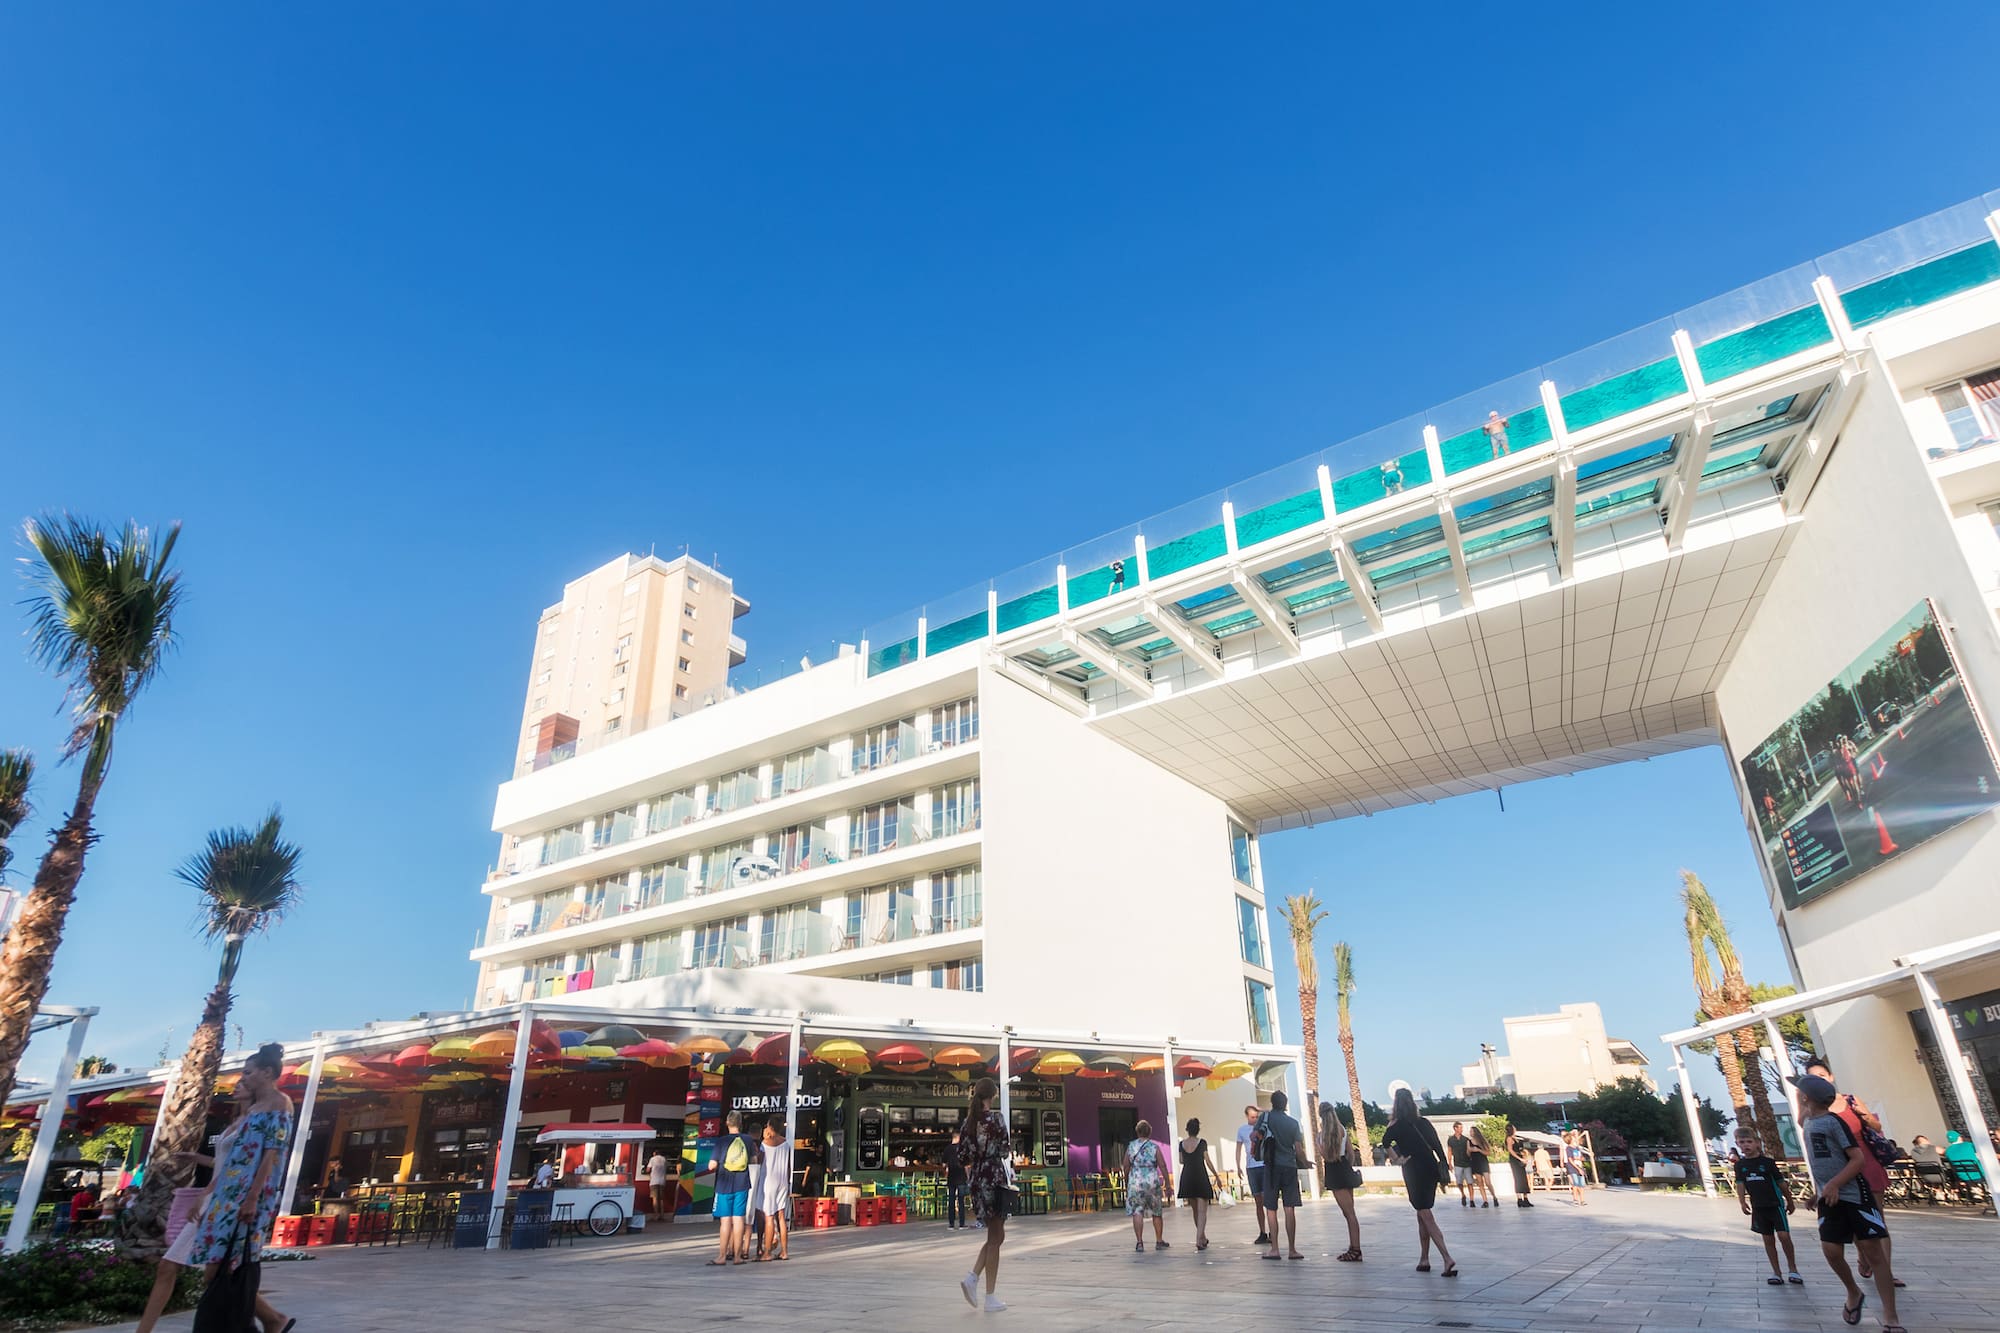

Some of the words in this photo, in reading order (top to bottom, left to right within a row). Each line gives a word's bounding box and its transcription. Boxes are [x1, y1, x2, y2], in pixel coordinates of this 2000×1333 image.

[1046, 1089, 1054, 1099] 13
[732, 1096, 781, 1109] URBAN
[785, 1095, 822, 1107] OOD
